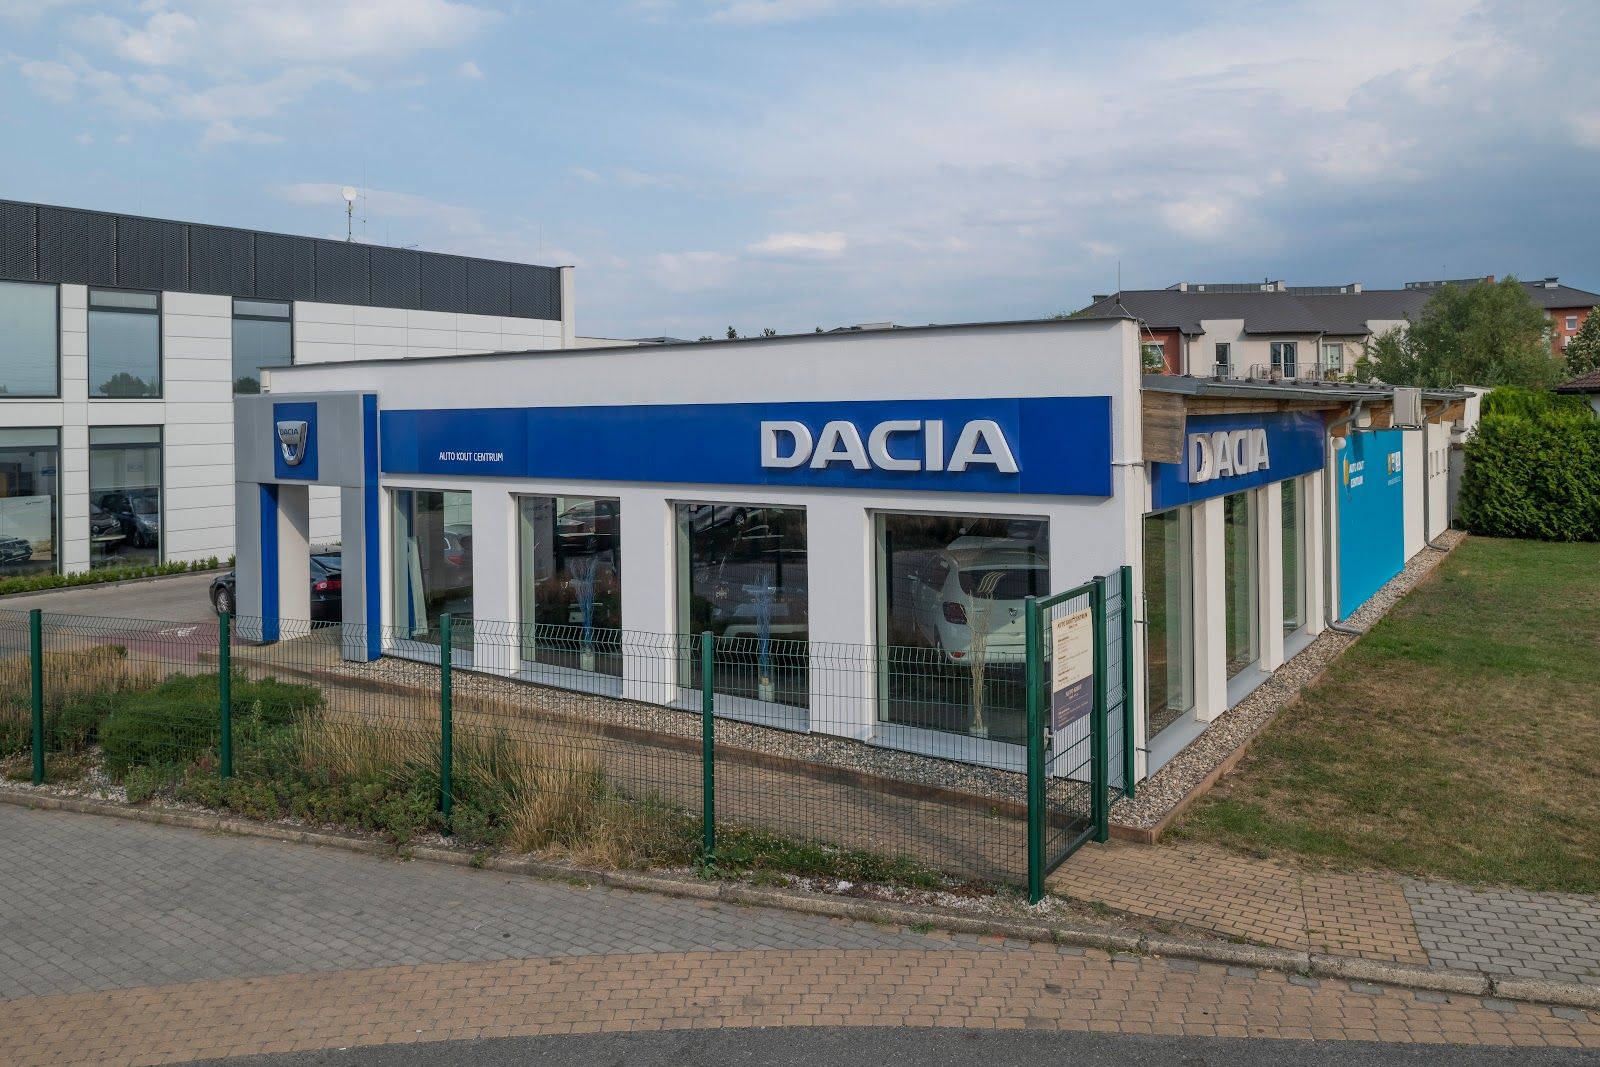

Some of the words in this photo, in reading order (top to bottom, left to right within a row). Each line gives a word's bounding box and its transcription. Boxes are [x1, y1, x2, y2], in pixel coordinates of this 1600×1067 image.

[280, 428, 299, 436] DACIA
[761, 420, 1020, 473] DACIA
[439, 451, 456, 461] AUTO
[456, 452, 473, 462] KOUT
[473, 452, 504, 462] CENTRUM
[1188, 428, 1270, 484] DACIA
